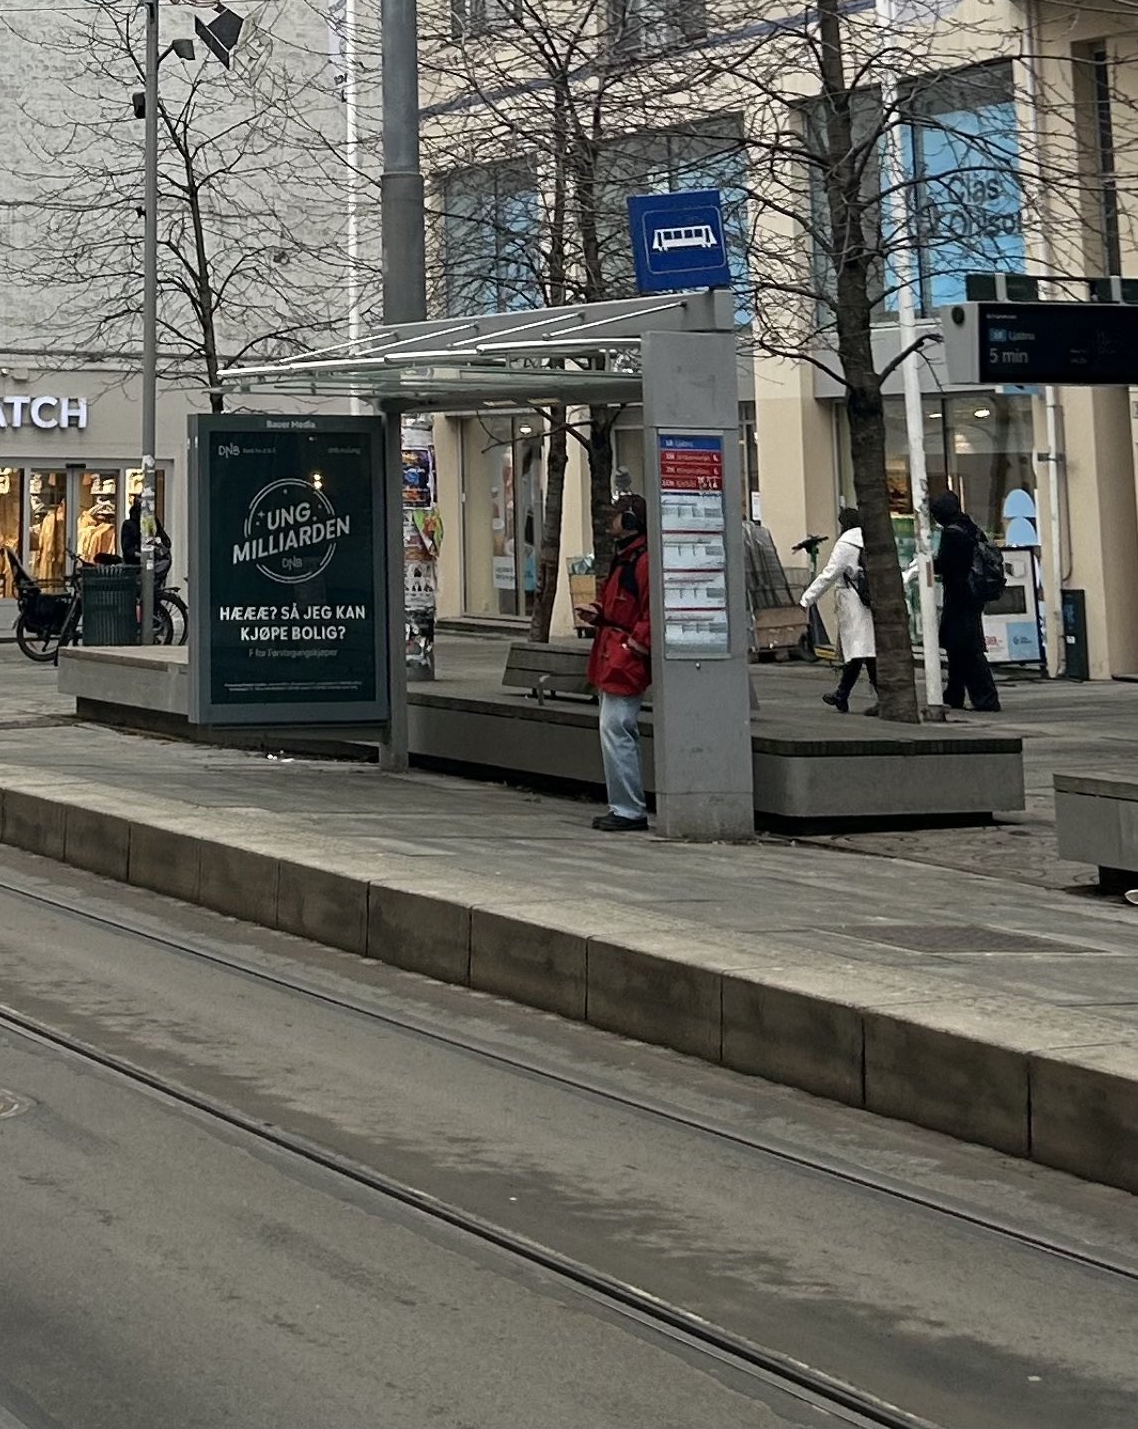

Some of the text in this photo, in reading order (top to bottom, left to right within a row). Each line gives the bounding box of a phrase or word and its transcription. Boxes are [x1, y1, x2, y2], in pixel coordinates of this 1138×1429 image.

[947, 174, 999, 200] Clas
[988, 348, 1029, 364] 5 min
[218, 441, 241, 459] DNB
[267, 502, 311, 530] UNG
[232, 514, 350, 565] MILLIARDEN
[282, 555, 303, 571] DNB
[219, 602, 366, 621] HÆÆÆ? SÅ JEG KAN
[240, 625, 346, 641] KJØPE BOLIG?
